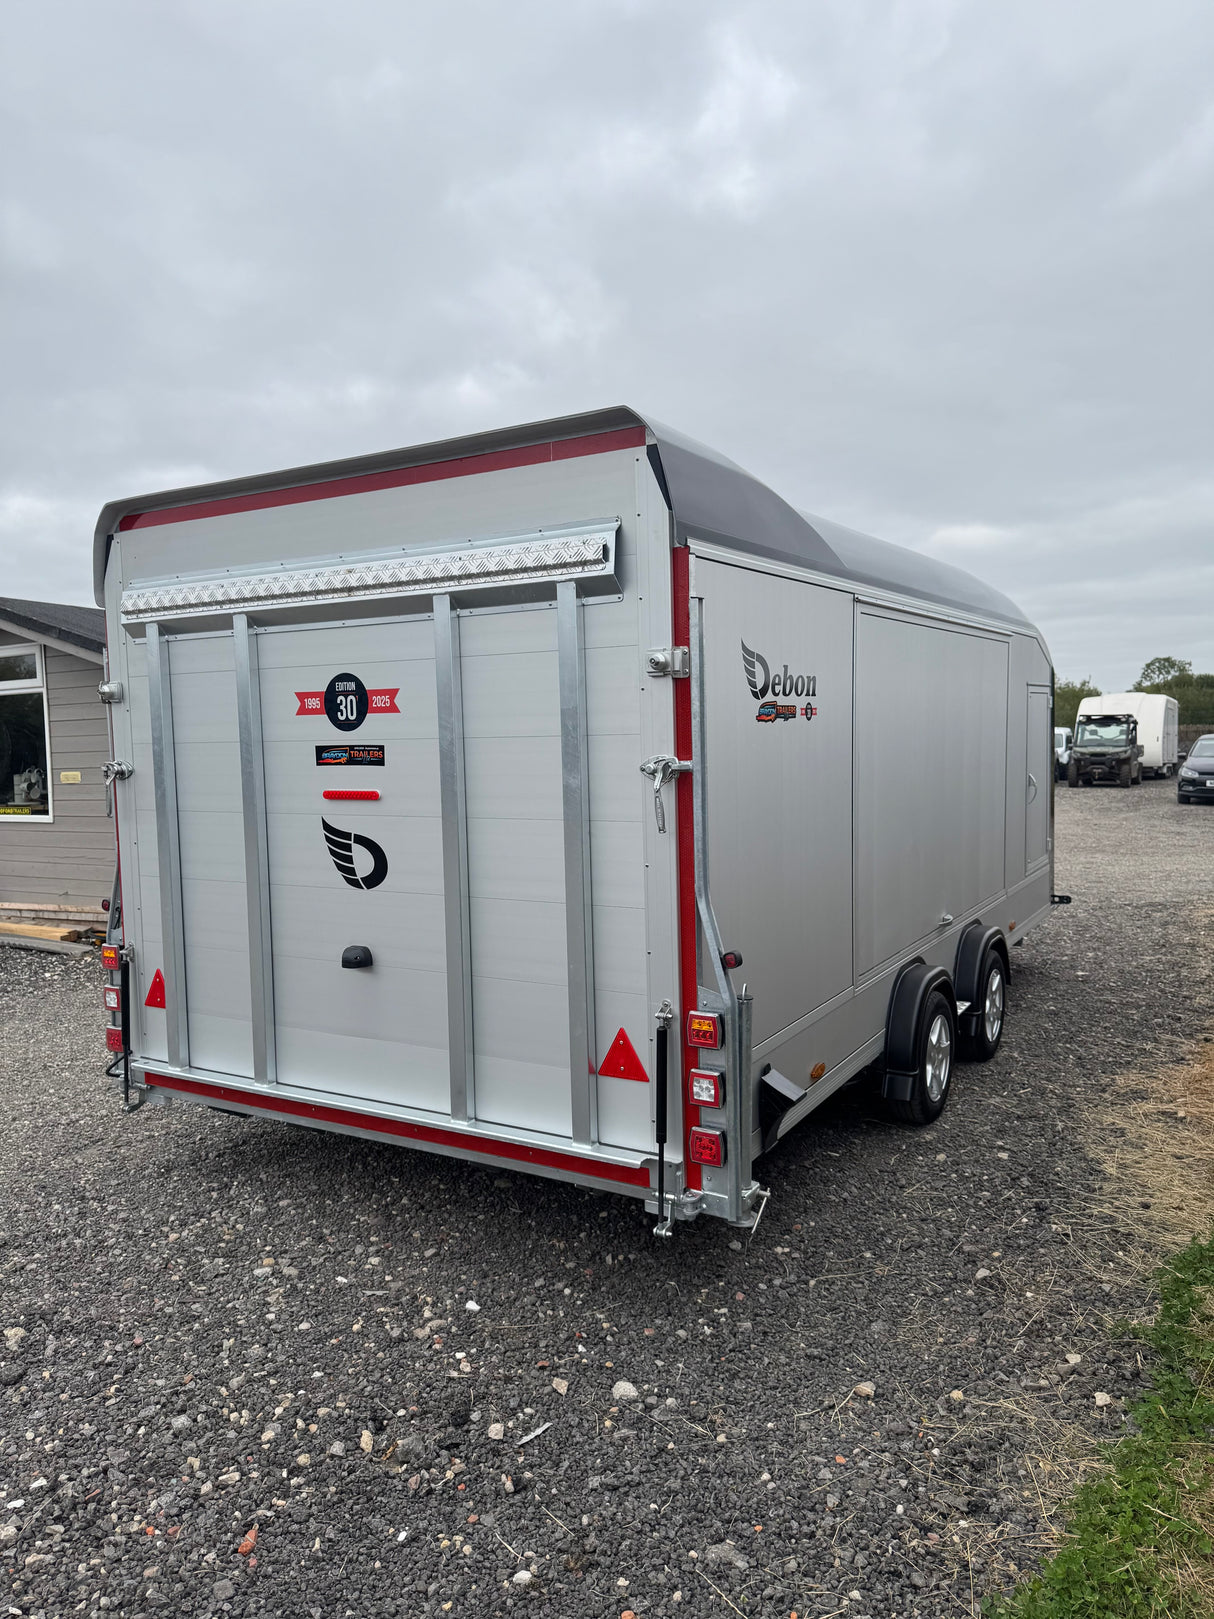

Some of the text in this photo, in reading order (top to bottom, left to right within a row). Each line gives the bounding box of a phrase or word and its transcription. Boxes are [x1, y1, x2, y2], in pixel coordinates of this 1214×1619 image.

[741, 636, 817, 700] Debon
[335, 681, 356, 691] EDITION
[304, 698, 321, 709] 1995
[372, 695, 390, 707] 2025
[350, 750, 384, 759] TRAILERS
